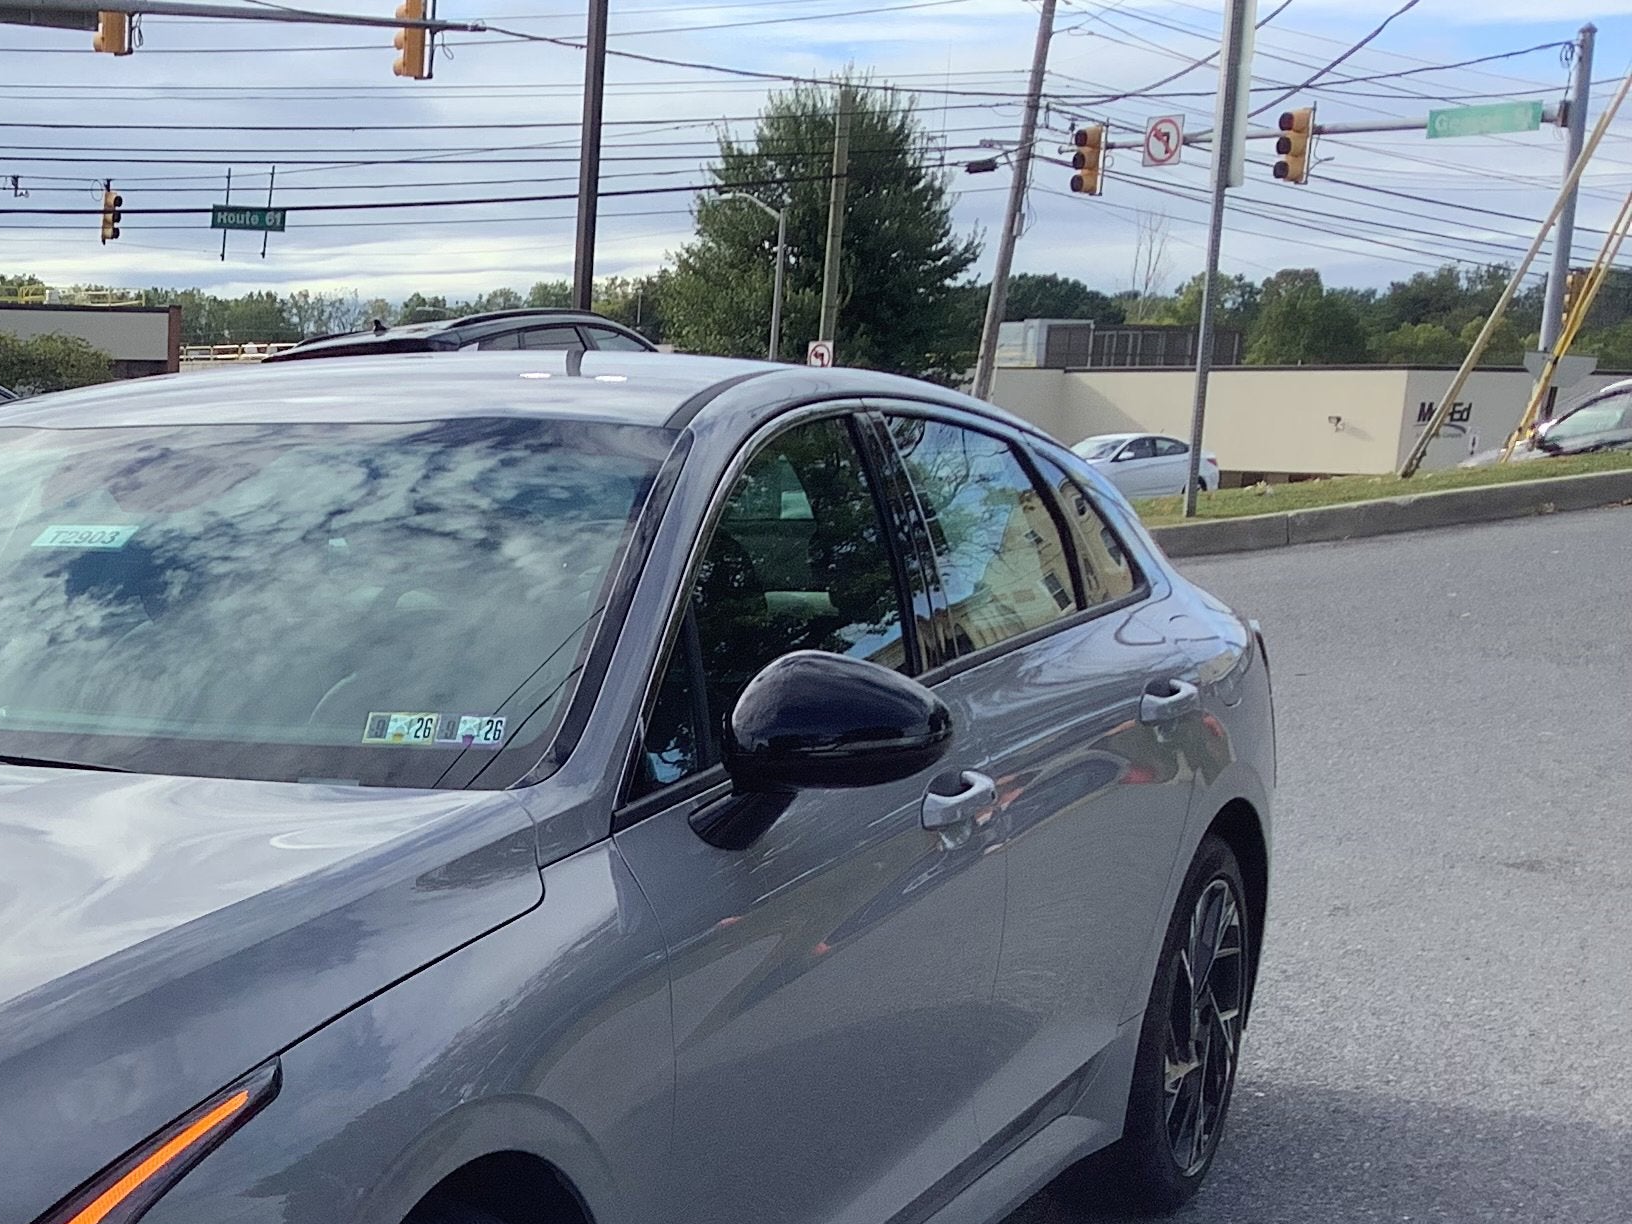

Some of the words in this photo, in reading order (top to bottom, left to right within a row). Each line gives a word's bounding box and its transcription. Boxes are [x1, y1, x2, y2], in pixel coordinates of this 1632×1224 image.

[217, 211, 259, 225] Route
[265, 211, 282, 226] 61
[1417, 402, 1472, 422] M-Ed
[49, 531, 120, 544] T2903
[414, 717, 433, 738] 26
[483, 719, 503, 741] 26
